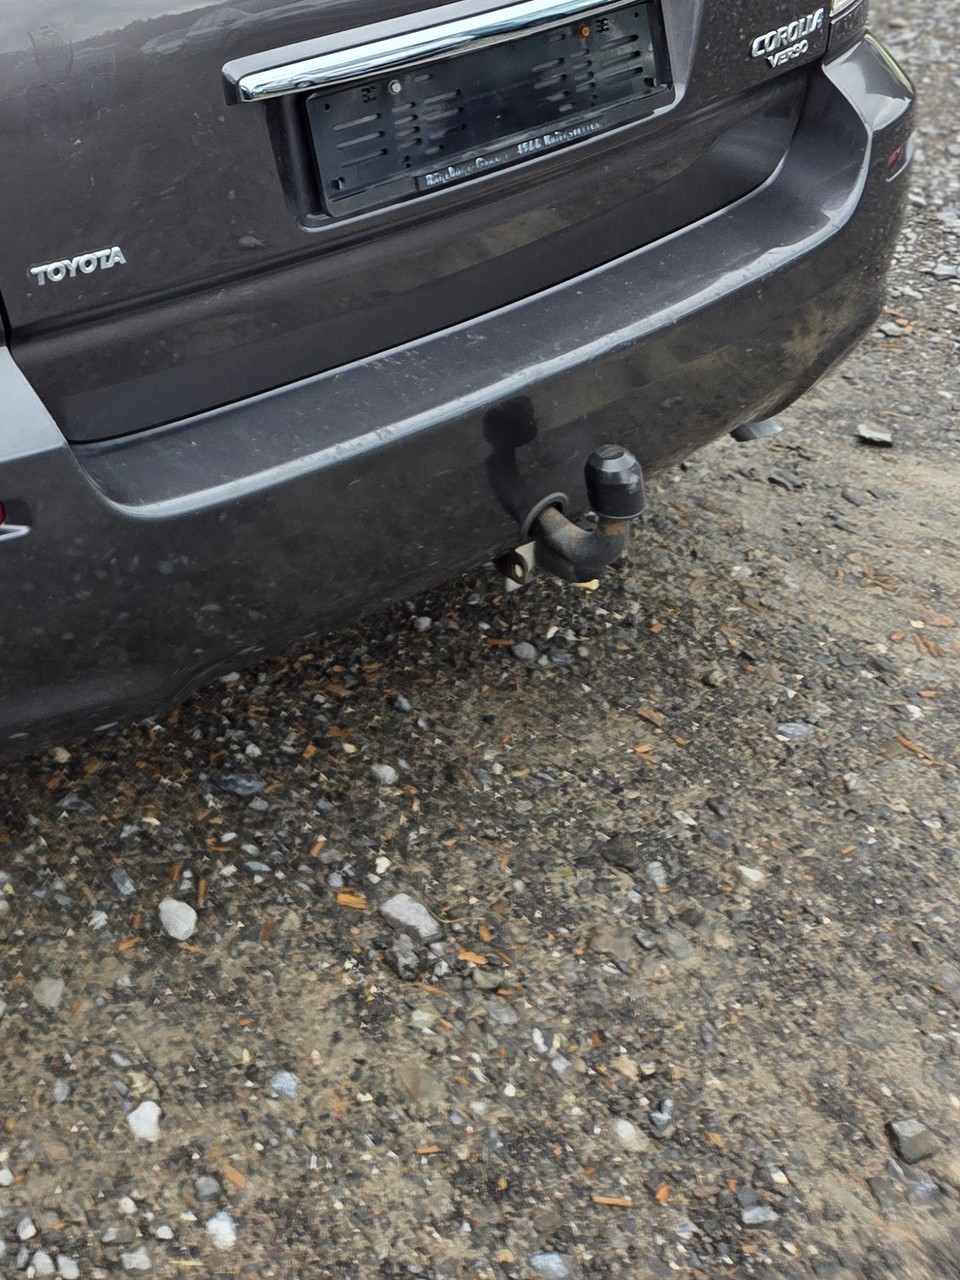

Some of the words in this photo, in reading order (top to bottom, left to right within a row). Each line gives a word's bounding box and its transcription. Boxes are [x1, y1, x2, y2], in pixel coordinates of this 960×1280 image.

[751, 7, 824, 58] COROLLA
[766, 39, 809, 68] VERSO
[30, 245, 127, 286] TOYOTA
